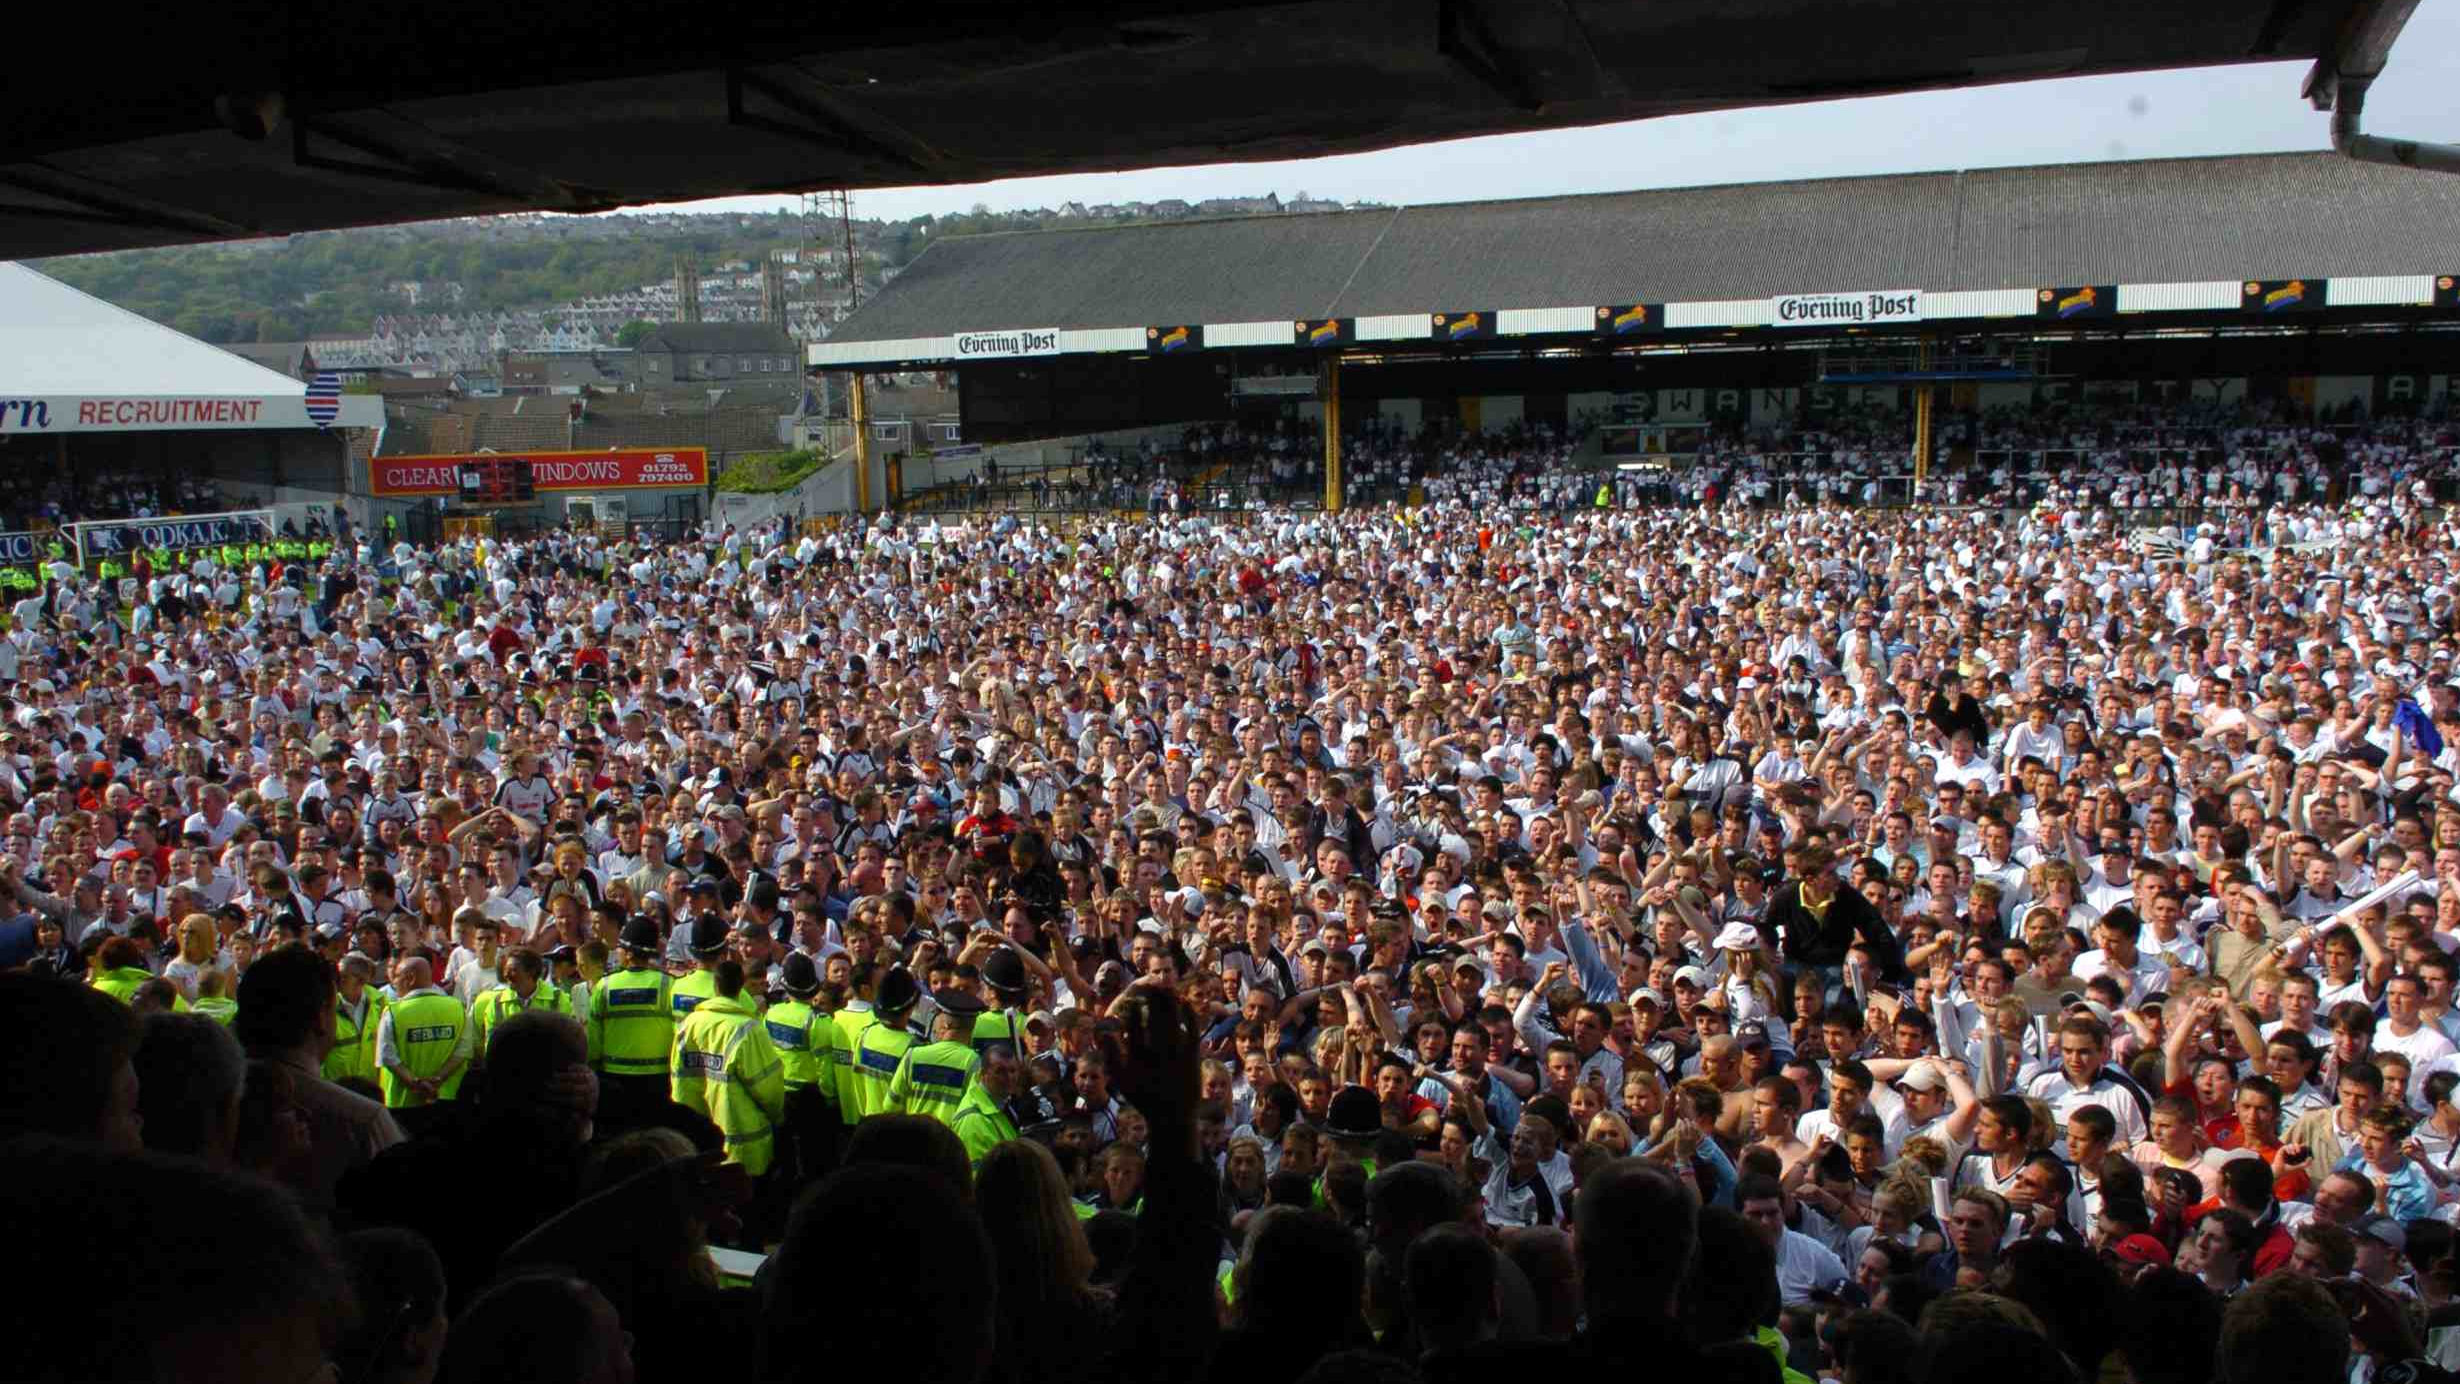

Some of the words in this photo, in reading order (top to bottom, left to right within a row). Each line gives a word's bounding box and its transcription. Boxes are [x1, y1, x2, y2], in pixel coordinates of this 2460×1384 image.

[1780, 297, 1864, 321] Evening
[1868, 294, 1917, 319] Post
[960, 333, 1020, 354] Evening
[1022, 332, 1056, 353] Post
[78, 400, 263, 425] RECRUITMENT
